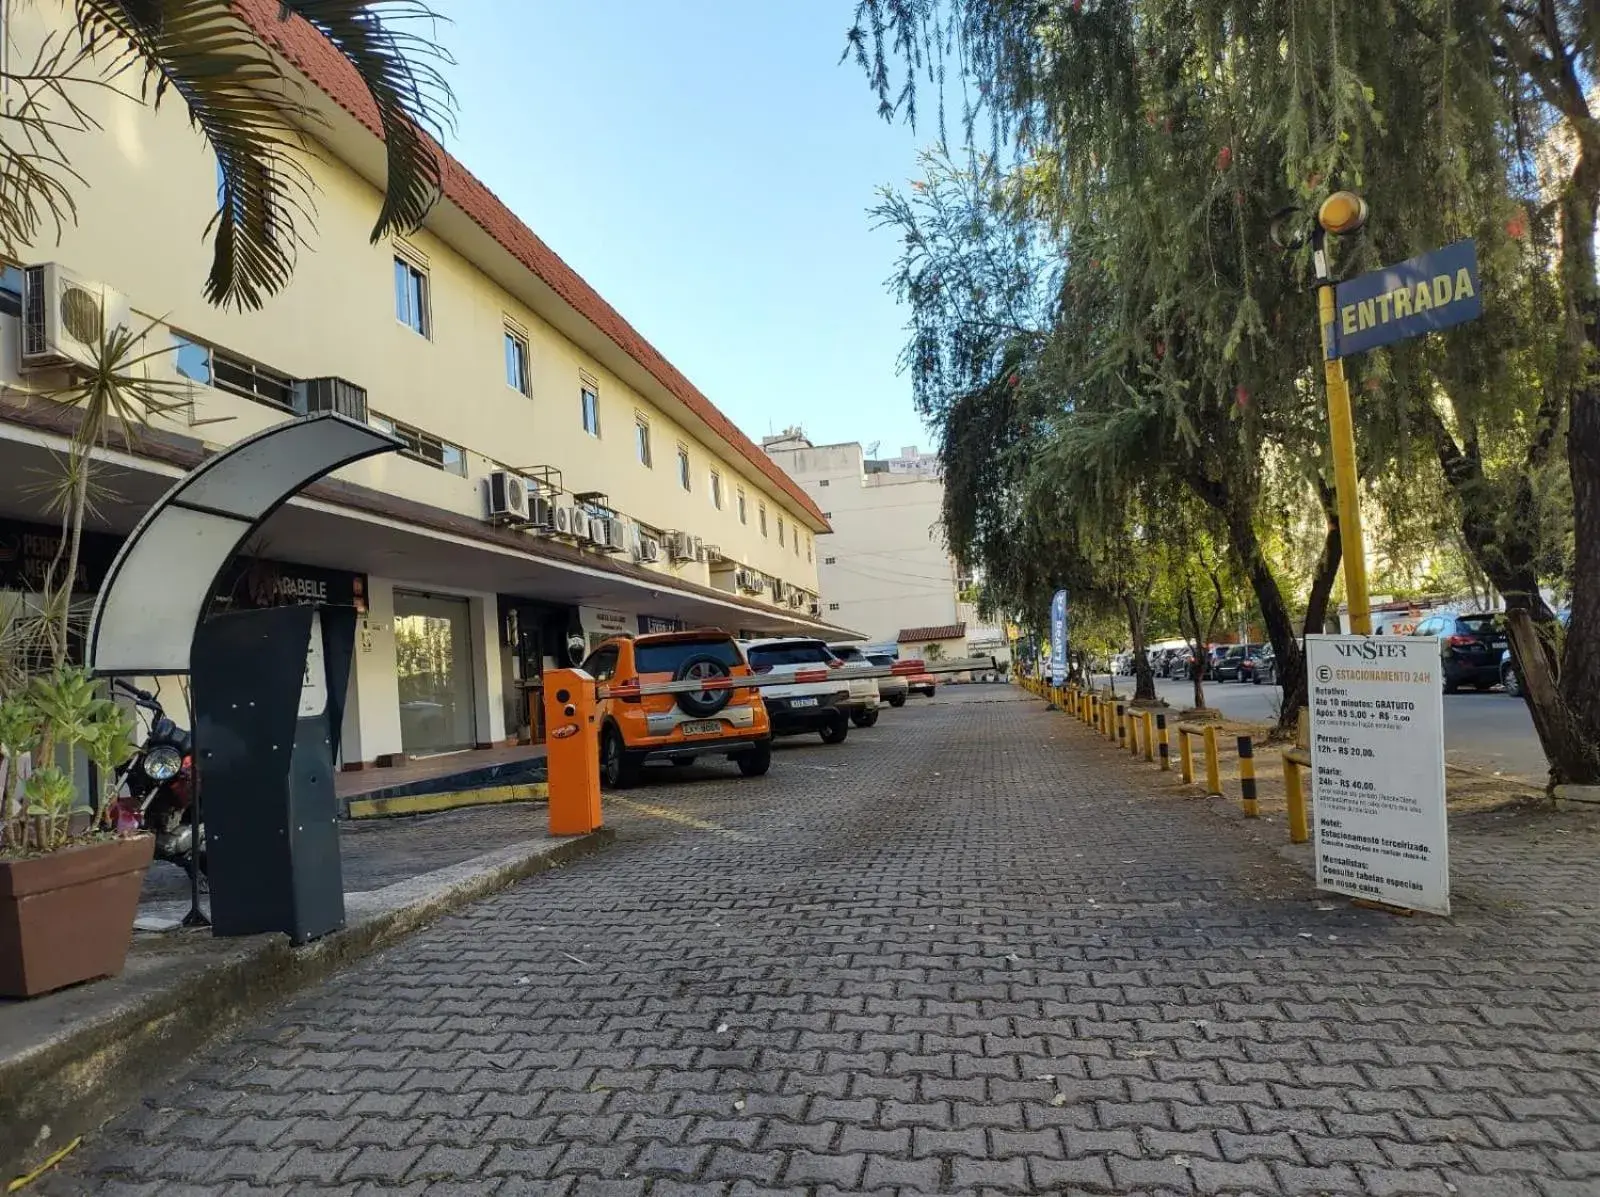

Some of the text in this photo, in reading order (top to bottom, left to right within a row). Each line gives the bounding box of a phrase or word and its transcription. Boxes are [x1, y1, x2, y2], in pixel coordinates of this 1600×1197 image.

[1341, 267, 1475, 336] ENTRADA
[1335, 640, 1407, 659] VINSTER
[1336, 669, 1410, 682] ESTACIONAMENTO
[1413, 671, 1431, 683] 24H
[1316, 686, 1348, 696] Rotativo:
[1330, 698, 1339, 706] 10
[1341, 699, 1373, 708] minutos:
[1375, 700, 1415, 711] GRATUITO
[1338, 709, 1348, 718] R$
[1379, 711, 1390, 720] R$
[1317, 734, 1350, 744] Pernoite:
[1318, 745, 1331, 753] 12h
[1338, 746, 1349, 756] R$
[1319, 777, 1333, 786] 24h
[1340, 778, 1351, 788] R$
[1321, 828, 1432, 854] Estacionamento terceirizado.
[1323, 865, 1424, 891] Consulte tabelas especiais
